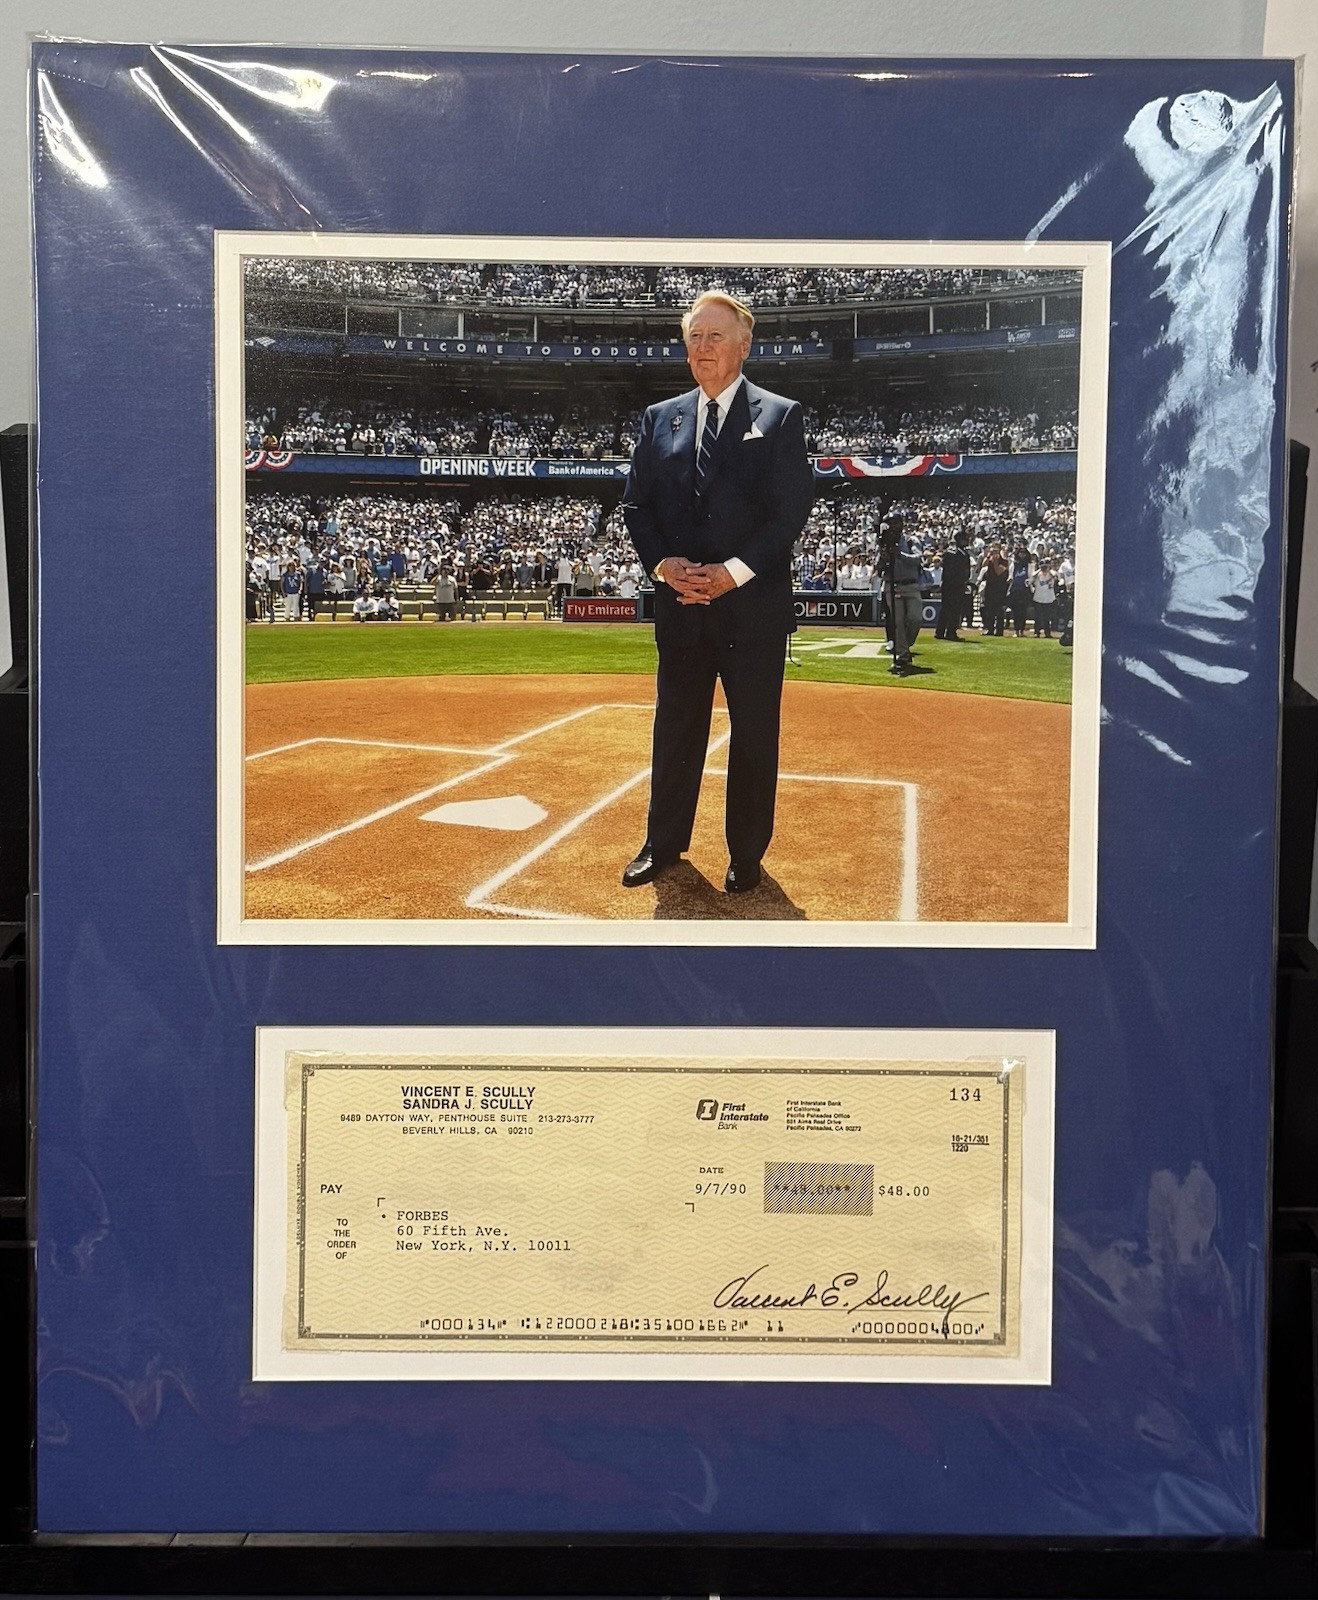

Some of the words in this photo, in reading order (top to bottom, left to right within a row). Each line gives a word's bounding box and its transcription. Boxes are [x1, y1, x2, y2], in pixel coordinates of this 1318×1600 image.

[383, 339, 504, 355] WELCOME
[525, 345, 551, 356] TO
[572, 346, 670, 358] DODGER
[420, 458, 489, 476] OPENING
[493, 460, 536, 477] WEEK
[580, 466, 614, 476] America
[567, 604, 586, 618] Fly
[588, 604, 636, 617] Emirates
[794, 601, 838, 617] OLED
[840, 603, 862, 617] TV
[401, 1086, 461, 1098] VINCENT
[466, 1086, 479, 1098] E.
[483, 1086, 536, 1099] SCULLY
[949, 1088, 982, 1102] 134
[402, 1099, 459, 1110] SANDRA
[464, 1099, 476, 1111] J.
[480, 1099, 533, 1111] SCULLY
[722, 1103, 746, 1111] First
[340, 1114, 361, 1122] 9489
[366, 1114, 405, 1122] DAYTON
[409, 1114, 433, 1123] WAY,
[439, 1115, 496, 1123] PENTHOUSE
[500, 1115, 528, 1123] SUITE
[538, 1115, 595, 1124] 213-273-3777
[720, 1113, 769, 1121] Interstate
[718, 1121, 738, 1130] Bank
[402, 1127, 446, 1136] BEVERLY
[449, 1127, 480, 1136] HILLS,
[484, 1127, 497, 1135] CA
[508, 1127, 534, 1136] 90210
[951, 1144, 969, 1153] 1220
[699, 1167, 724, 1175] DATE
[320, 1184, 343, 1194] PAY
[695, 1183, 747, 1195] 9/7/90
[878, 1185, 930, 1197] $48.00
[396, 1210, 449, 1221] FORBES
[336, 1218, 349, 1227] TO
[334, 1229, 351, 1238] THE
[396, 1226, 414, 1236] 60
[422, 1225, 467, 1237] Fifth
[475, 1226, 509, 1237] Ave.
[326, 1240, 357, 1249] ORDER
[396, 1240, 421, 1251] New
[431, 1240, 474, 1253] York,
[484, 1240, 518, 1251] N.Y.
[528, 1240, 571, 1251] 10011
[335, 1251, 348, 1260] OF
[847, 1270, 990, 1340] Scully
